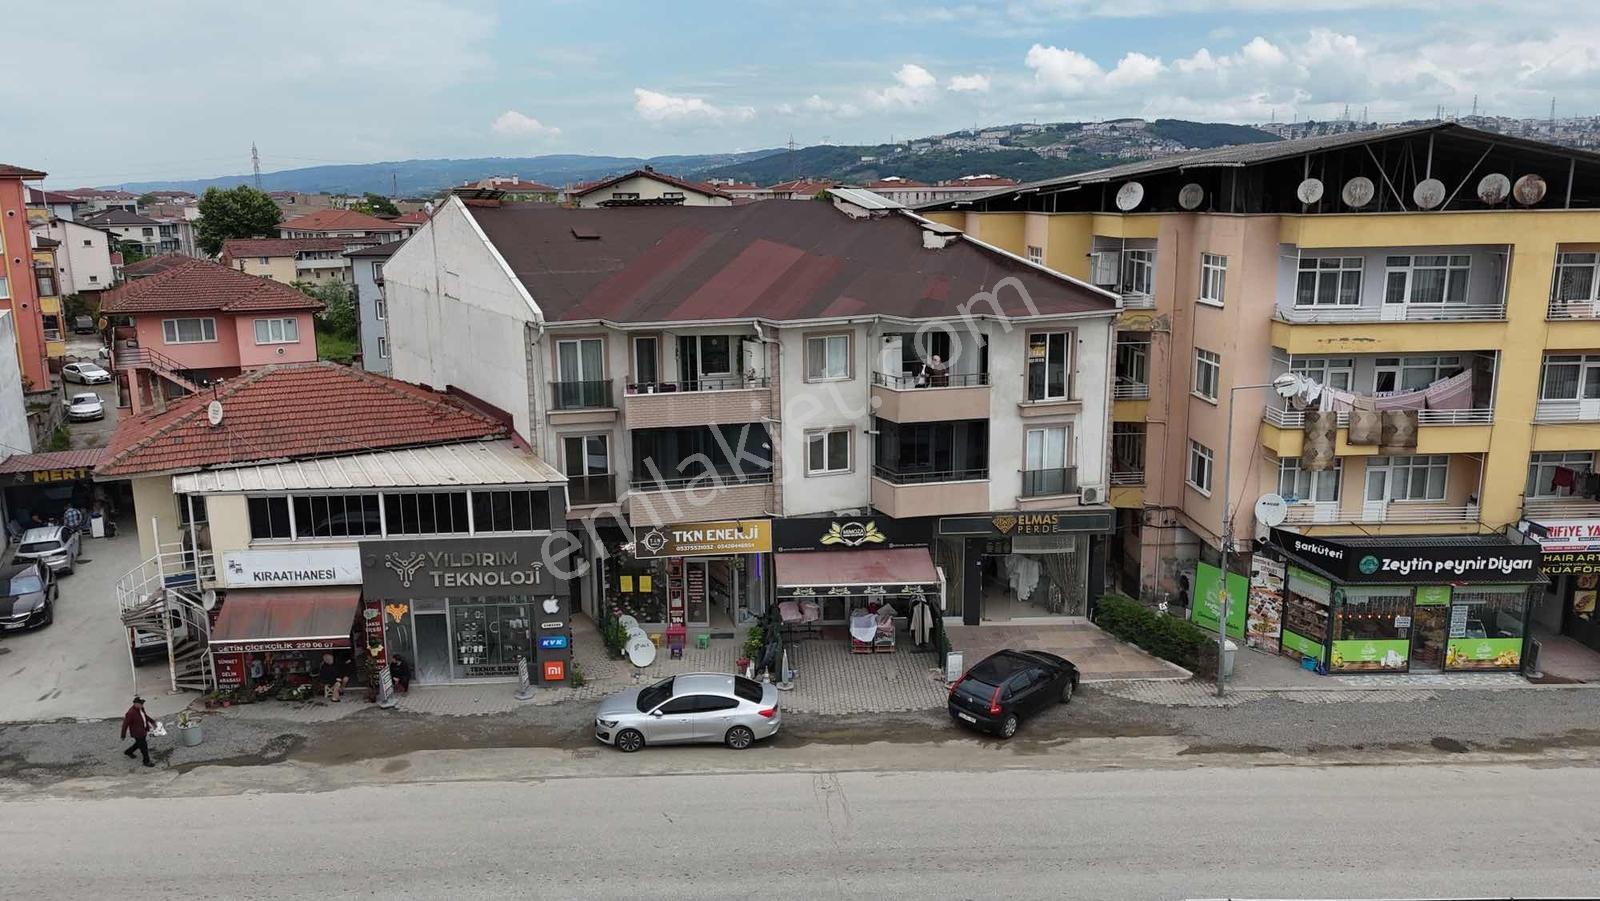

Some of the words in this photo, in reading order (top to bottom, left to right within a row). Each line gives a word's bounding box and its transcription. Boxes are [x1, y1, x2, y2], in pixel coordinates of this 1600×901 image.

[33, 467, 86, 482] MERT
[1018, 514, 1058, 525] ELMAS
[672, 530, 703, 542] TKN
[707, 525, 758, 540] ENERJİ
[1018, 525, 1058, 533] PERDE
[1294, 540, 1343, 559] Şarküteri
[427, 552, 518, 567] YILDIRIM
[1382, 558, 1432, 575] Zeytin
[1435, 556, 1487, 574] peynir
[1488, 556, 1533, 574] Diyarı
[253, 568, 336, 581] KIRAATHANESİ
[429, 566, 541, 587] TEKNOLOJİ
[1542, 565, 1600, 573] KUAFÖR
